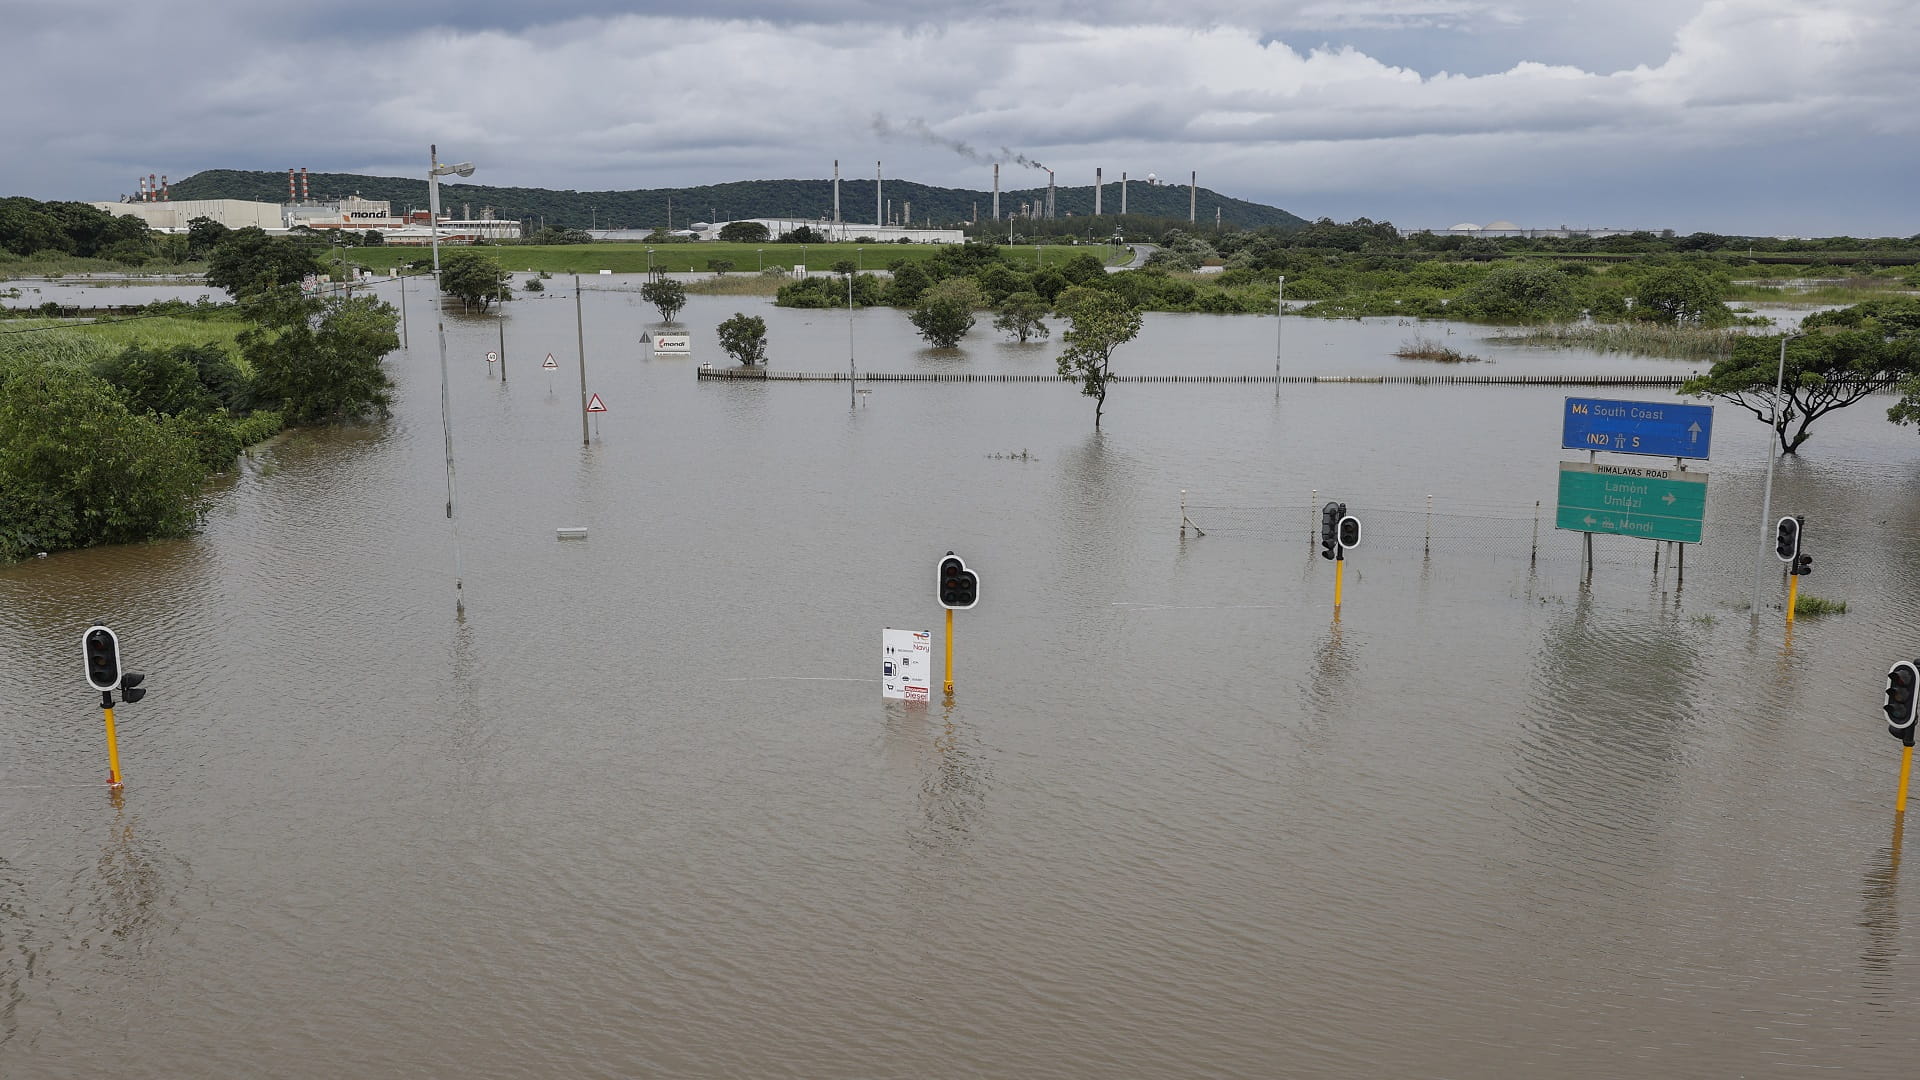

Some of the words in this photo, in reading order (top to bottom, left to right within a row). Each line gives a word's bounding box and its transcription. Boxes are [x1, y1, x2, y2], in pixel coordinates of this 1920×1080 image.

[350, 210, 387, 218] mondi
[1572, 403, 1588, 415] M4
[1593, 404, 1626, 417] South
[1631, 407, 1663, 420] Coast
[1586, 433, 1609, 445] (N2)
[1632, 436, 1640, 448] S
[1597, 465, 1642, 477] HIMALAYAS
[1646, 469, 1668, 479] ROAD
[1604, 481, 1648, 495] Lamont
[1604, 495, 1642, 508] Umlazi
[1619, 519, 1653, 533] Mondi
[913, 644, 930, 653] Navy
[905, 691, 927, 700] Diesel
